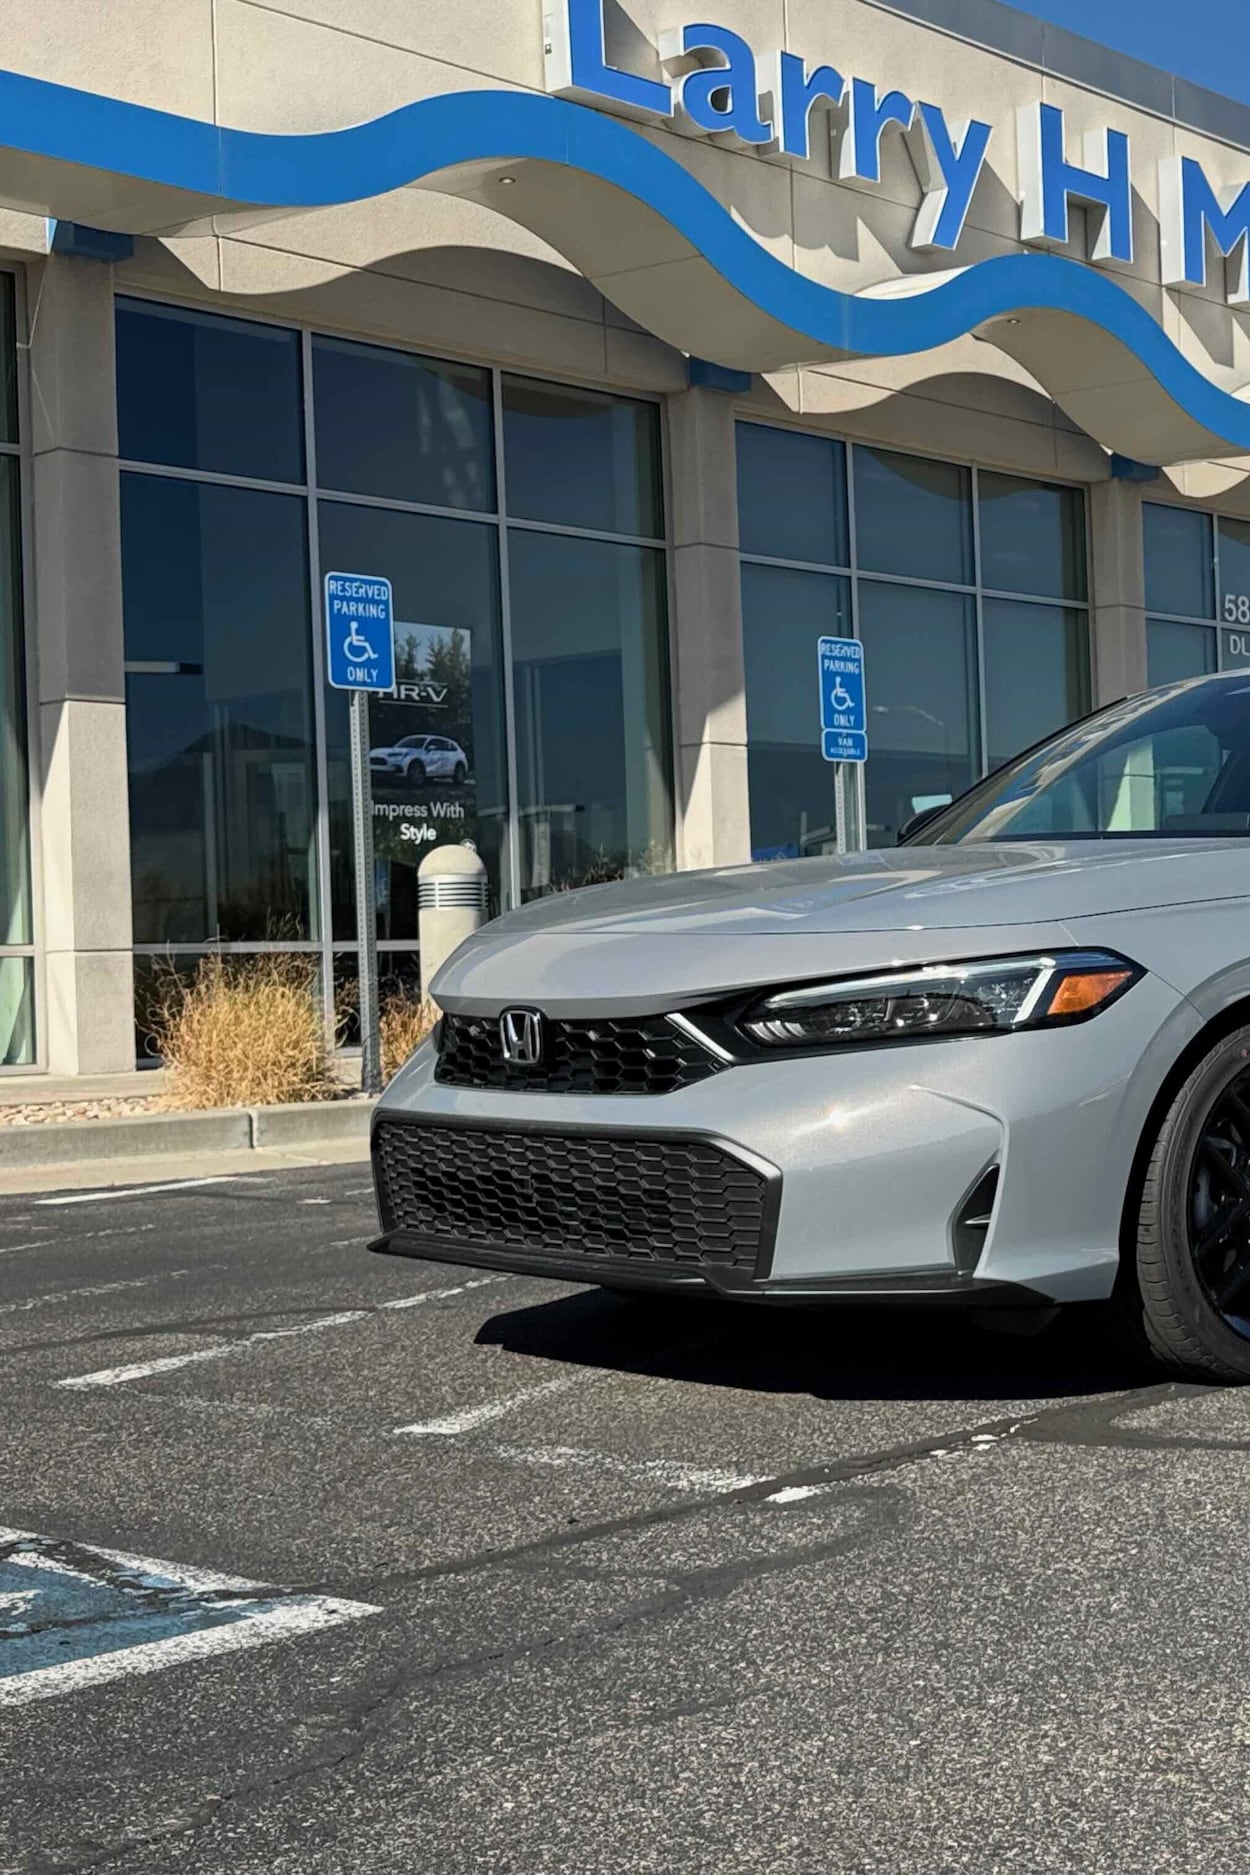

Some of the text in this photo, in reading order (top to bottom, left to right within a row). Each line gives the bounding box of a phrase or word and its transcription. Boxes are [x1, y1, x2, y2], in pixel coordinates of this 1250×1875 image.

[566, 0, 993, 250] Larry
[1038, 102, 1134, 264] H
[329, 580, 389, 601] RESERVED
[333, 599, 386, 619] PARKING
[820, 643, 862, 659] RESERVED
[346, 666, 378, 683] ONLY
[823, 659, 860, 674] PARKING
[833, 713, 855, 727] ONLY
[837, 736, 854, 747] VAN
[430, 801, 465, 818] With
[400, 822, 437, 845] Style
